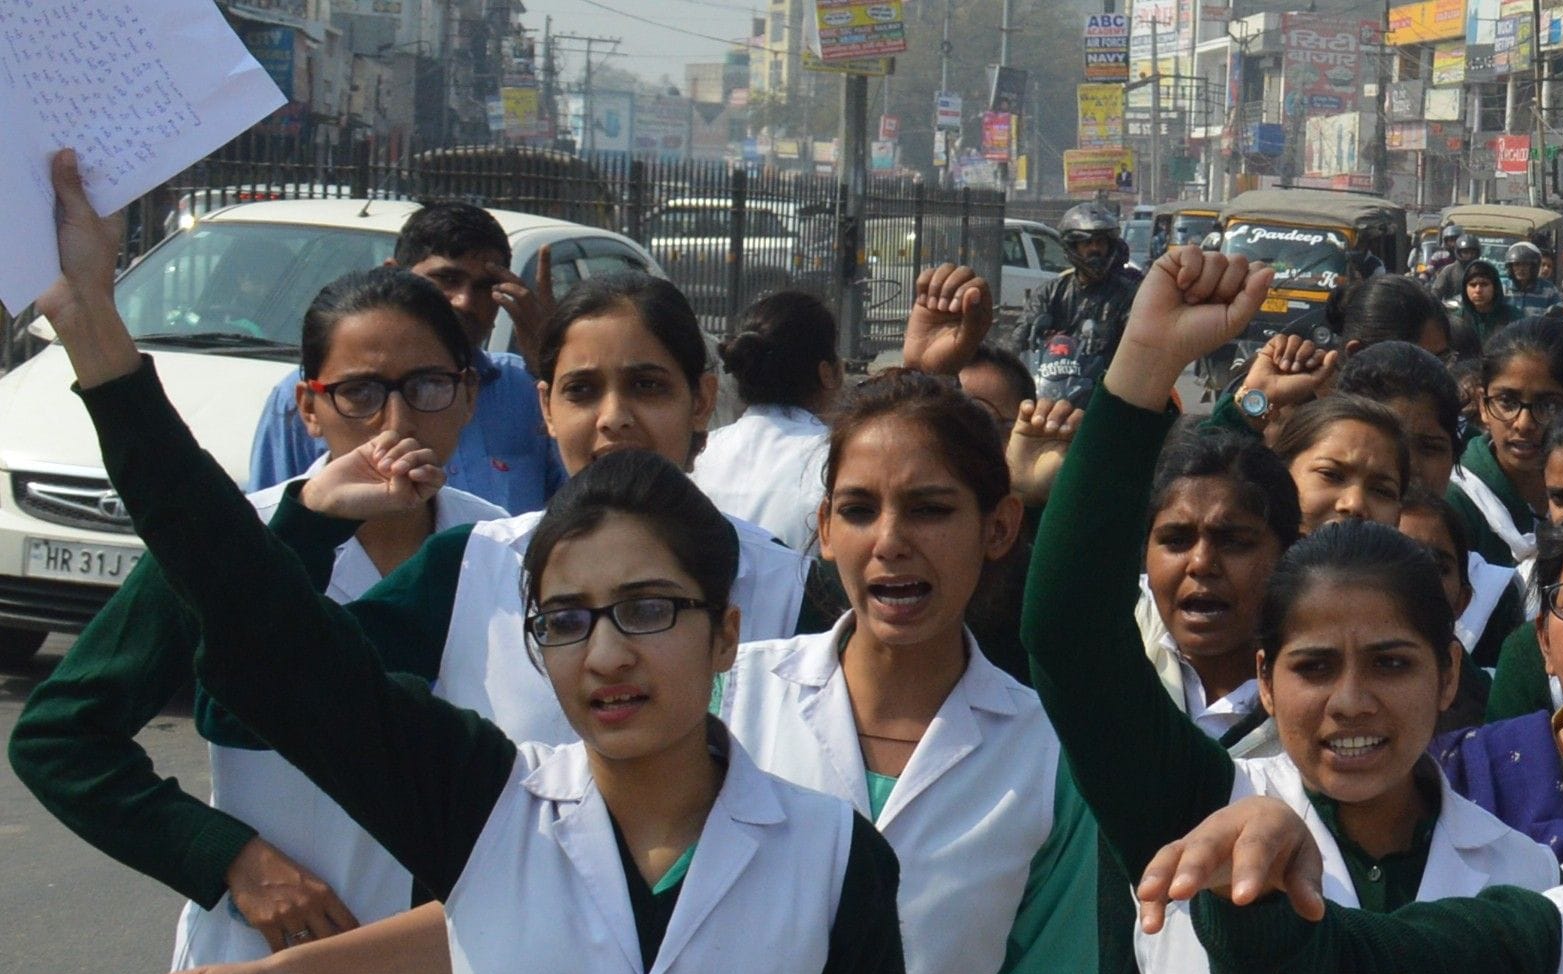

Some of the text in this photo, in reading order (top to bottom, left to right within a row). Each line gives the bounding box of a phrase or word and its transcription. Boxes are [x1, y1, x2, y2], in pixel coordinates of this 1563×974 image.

[1088, 15, 1125, 27] ABC
[1087, 53, 1126, 63] NAVY
[1247, 227, 1324, 246] Pardeep
[45, 548, 73, 573] HR
